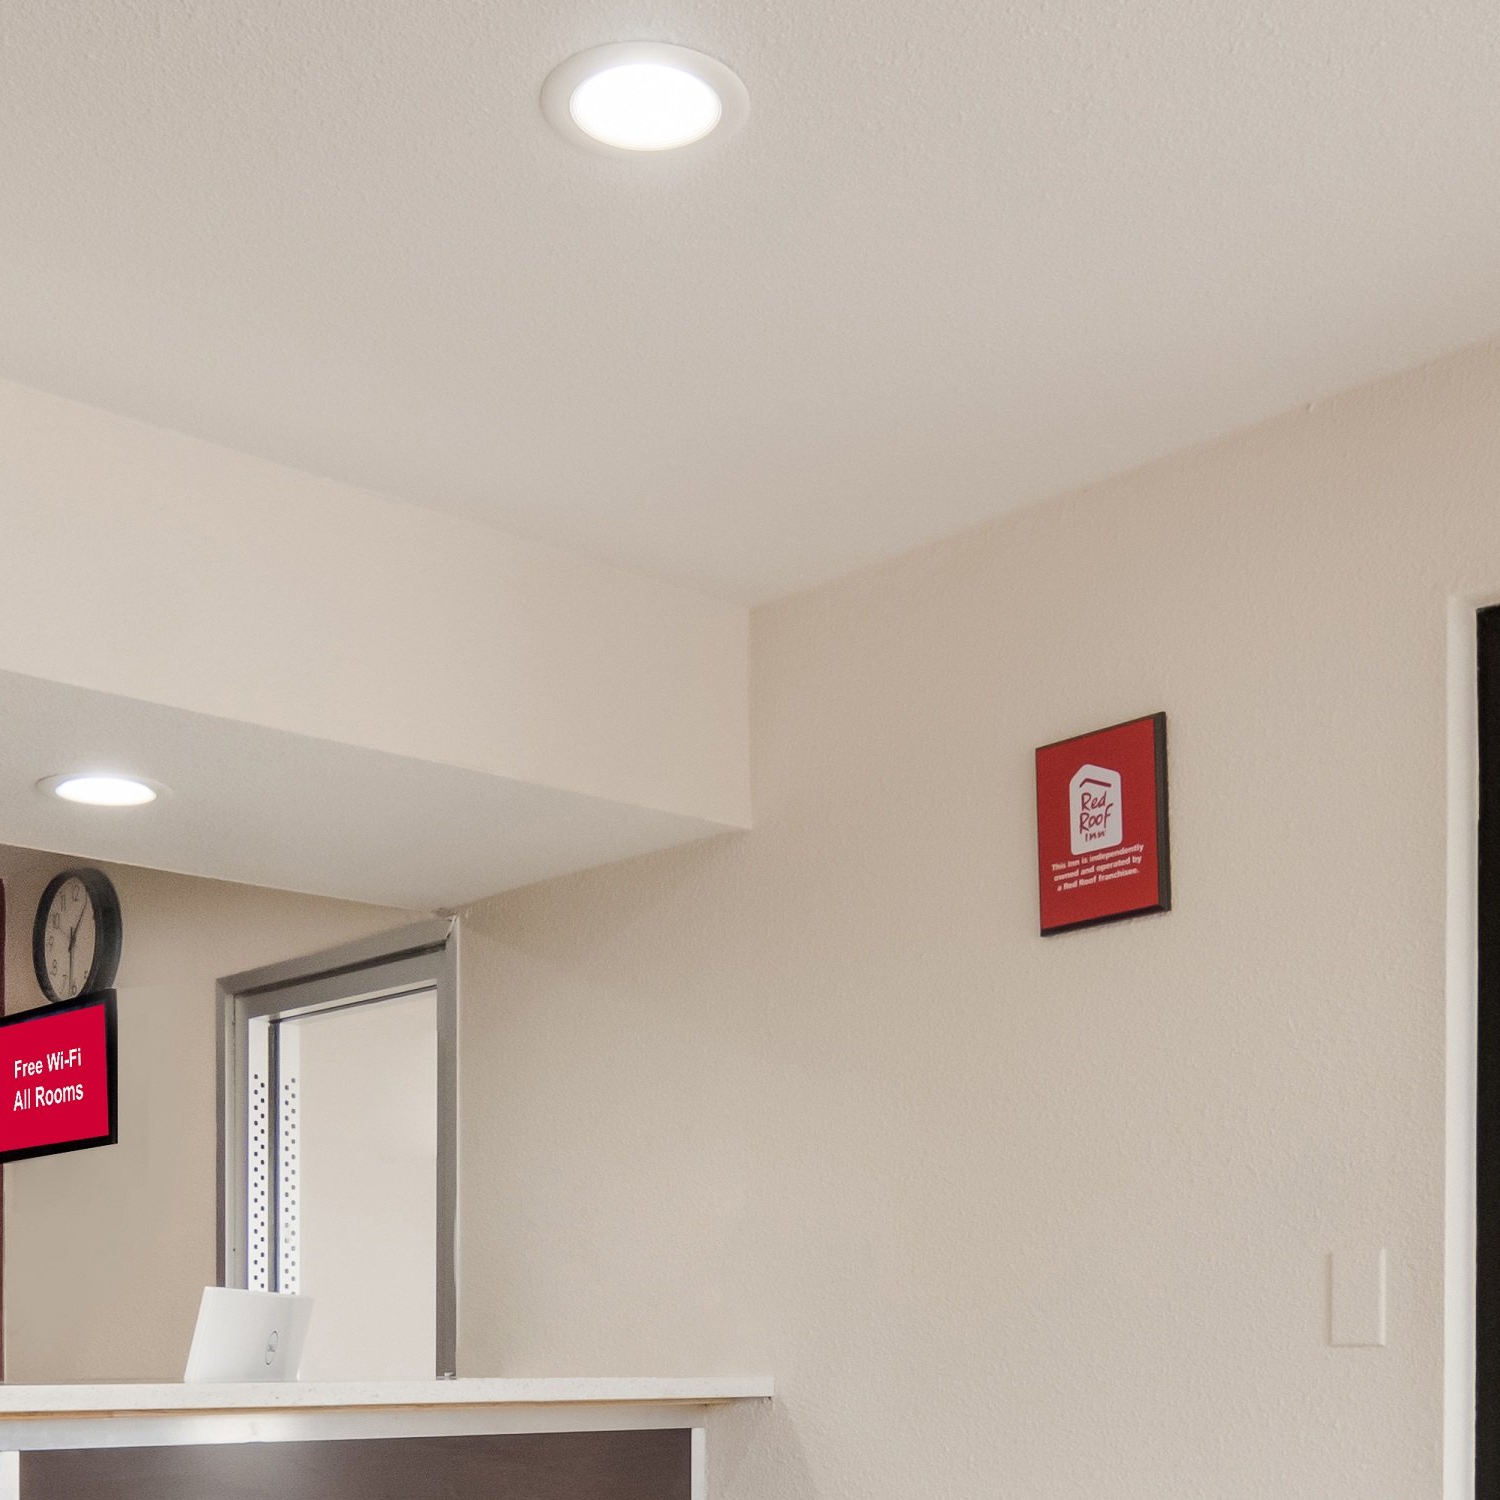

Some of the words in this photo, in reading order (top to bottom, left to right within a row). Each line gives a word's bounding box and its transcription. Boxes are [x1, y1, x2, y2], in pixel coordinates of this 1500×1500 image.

[1081, 791, 1107, 811] Red
[1080, 803, 1114, 834] Roof
[1089, 844, 1144, 862] independently
[1053, 869, 1079, 881] owned
[1080, 865, 1095, 876] and
[1096, 857, 1131, 872] operated
[1132, 856, 1143, 864] by
[1079, 875, 1097, 886] Roof
[14, 1060, 43, 1079] Free
[47, 1048, 82, 1072] Wi-Fi
[13, 1089, 31, 1112] All
[35, 1083, 84, 1108] Rooms
